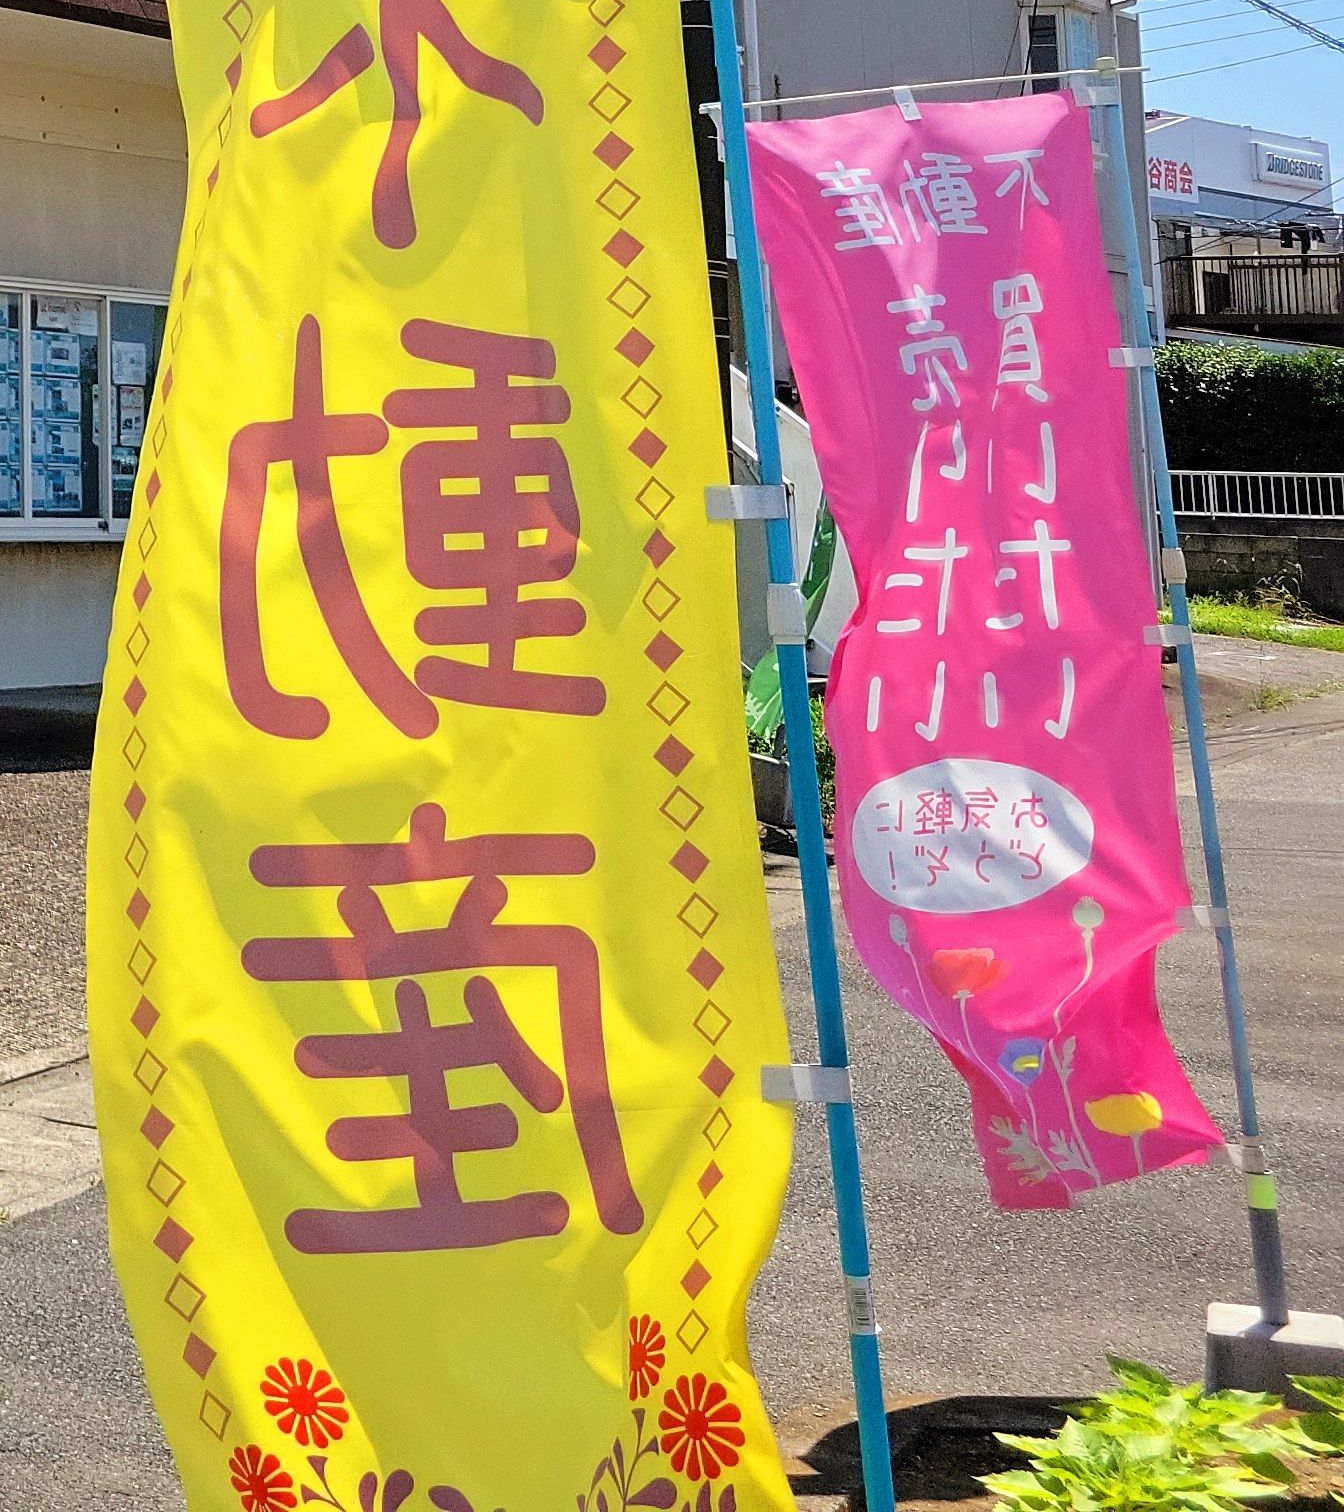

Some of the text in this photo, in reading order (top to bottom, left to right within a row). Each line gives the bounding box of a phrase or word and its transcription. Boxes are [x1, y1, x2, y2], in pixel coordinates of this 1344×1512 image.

[1148, 156, 1193, 195] 谷商会
[1266, 152, 1325, 181] BRIDGESTONE
